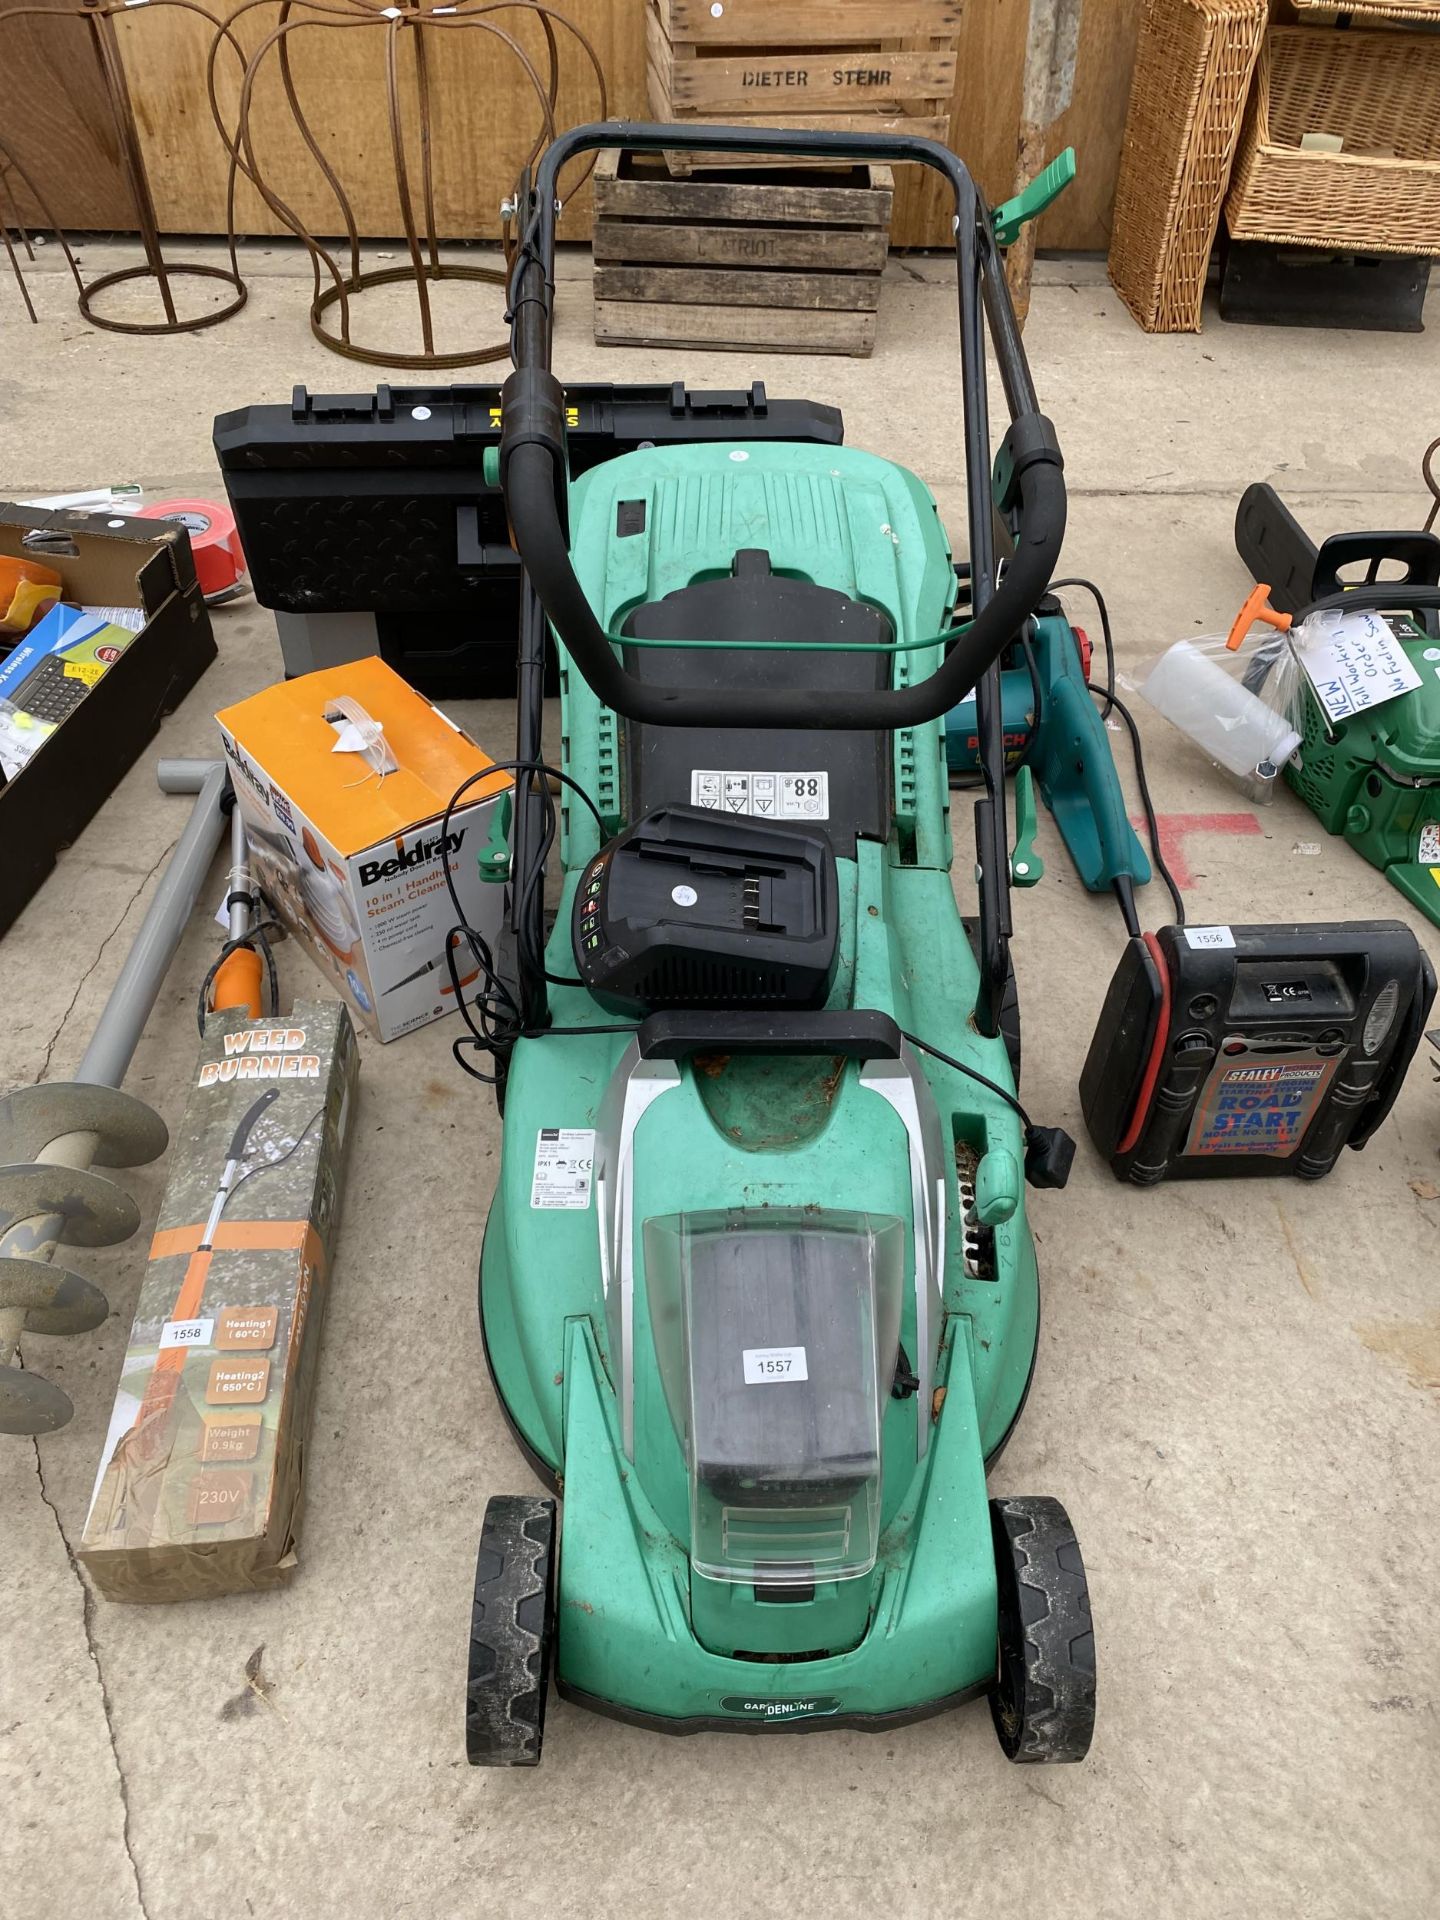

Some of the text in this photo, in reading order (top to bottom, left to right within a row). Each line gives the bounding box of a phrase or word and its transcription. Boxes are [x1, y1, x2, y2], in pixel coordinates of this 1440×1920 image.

[742, 70, 892, 86] DIETER STEHR
[1358, 614, 1380, 638] Saw
[3, 646, 35, 675] Wireless
[1351, 640, 1378, 677] Order
[1387, 677, 1409, 693] No
[1316, 680, 1352, 717] NEW
[1351, 686, 1373, 706] Full
[967, 733, 1026, 750] BCH
[795, 779, 818, 796] 88
[358, 829, 466, 888] Beldray
[366, 897, 380, 908] 10
[382, 891, 394, 902] in
[367, 879, 447, 918] Steam Cleane
[1197, 934, 1223, 944] 1556
[223, 1028, 306, 1056] WEED
[198, 1055, 320, 1088] BURNER
[1228, 1068, 1280, 1081] SEALEY
[1281, 1070, 1322, 1079] PRODUCTS
[1218, 1094, 1303, 1111] ROAD
[1212, 1111, 1302, 1131] START
[226, 1320, 271, 1329] Heating1
[174, 1328, 202, 1340] 1558
[757, 1360, 792, 1374] 1557
[216, 1371, 265, 1381] Heating2
[209, 1428, 250, 1439] Weight
[199, 1490, 240, 1504] 230V
[744, 1701, 815, 1716] GARDENLINE
